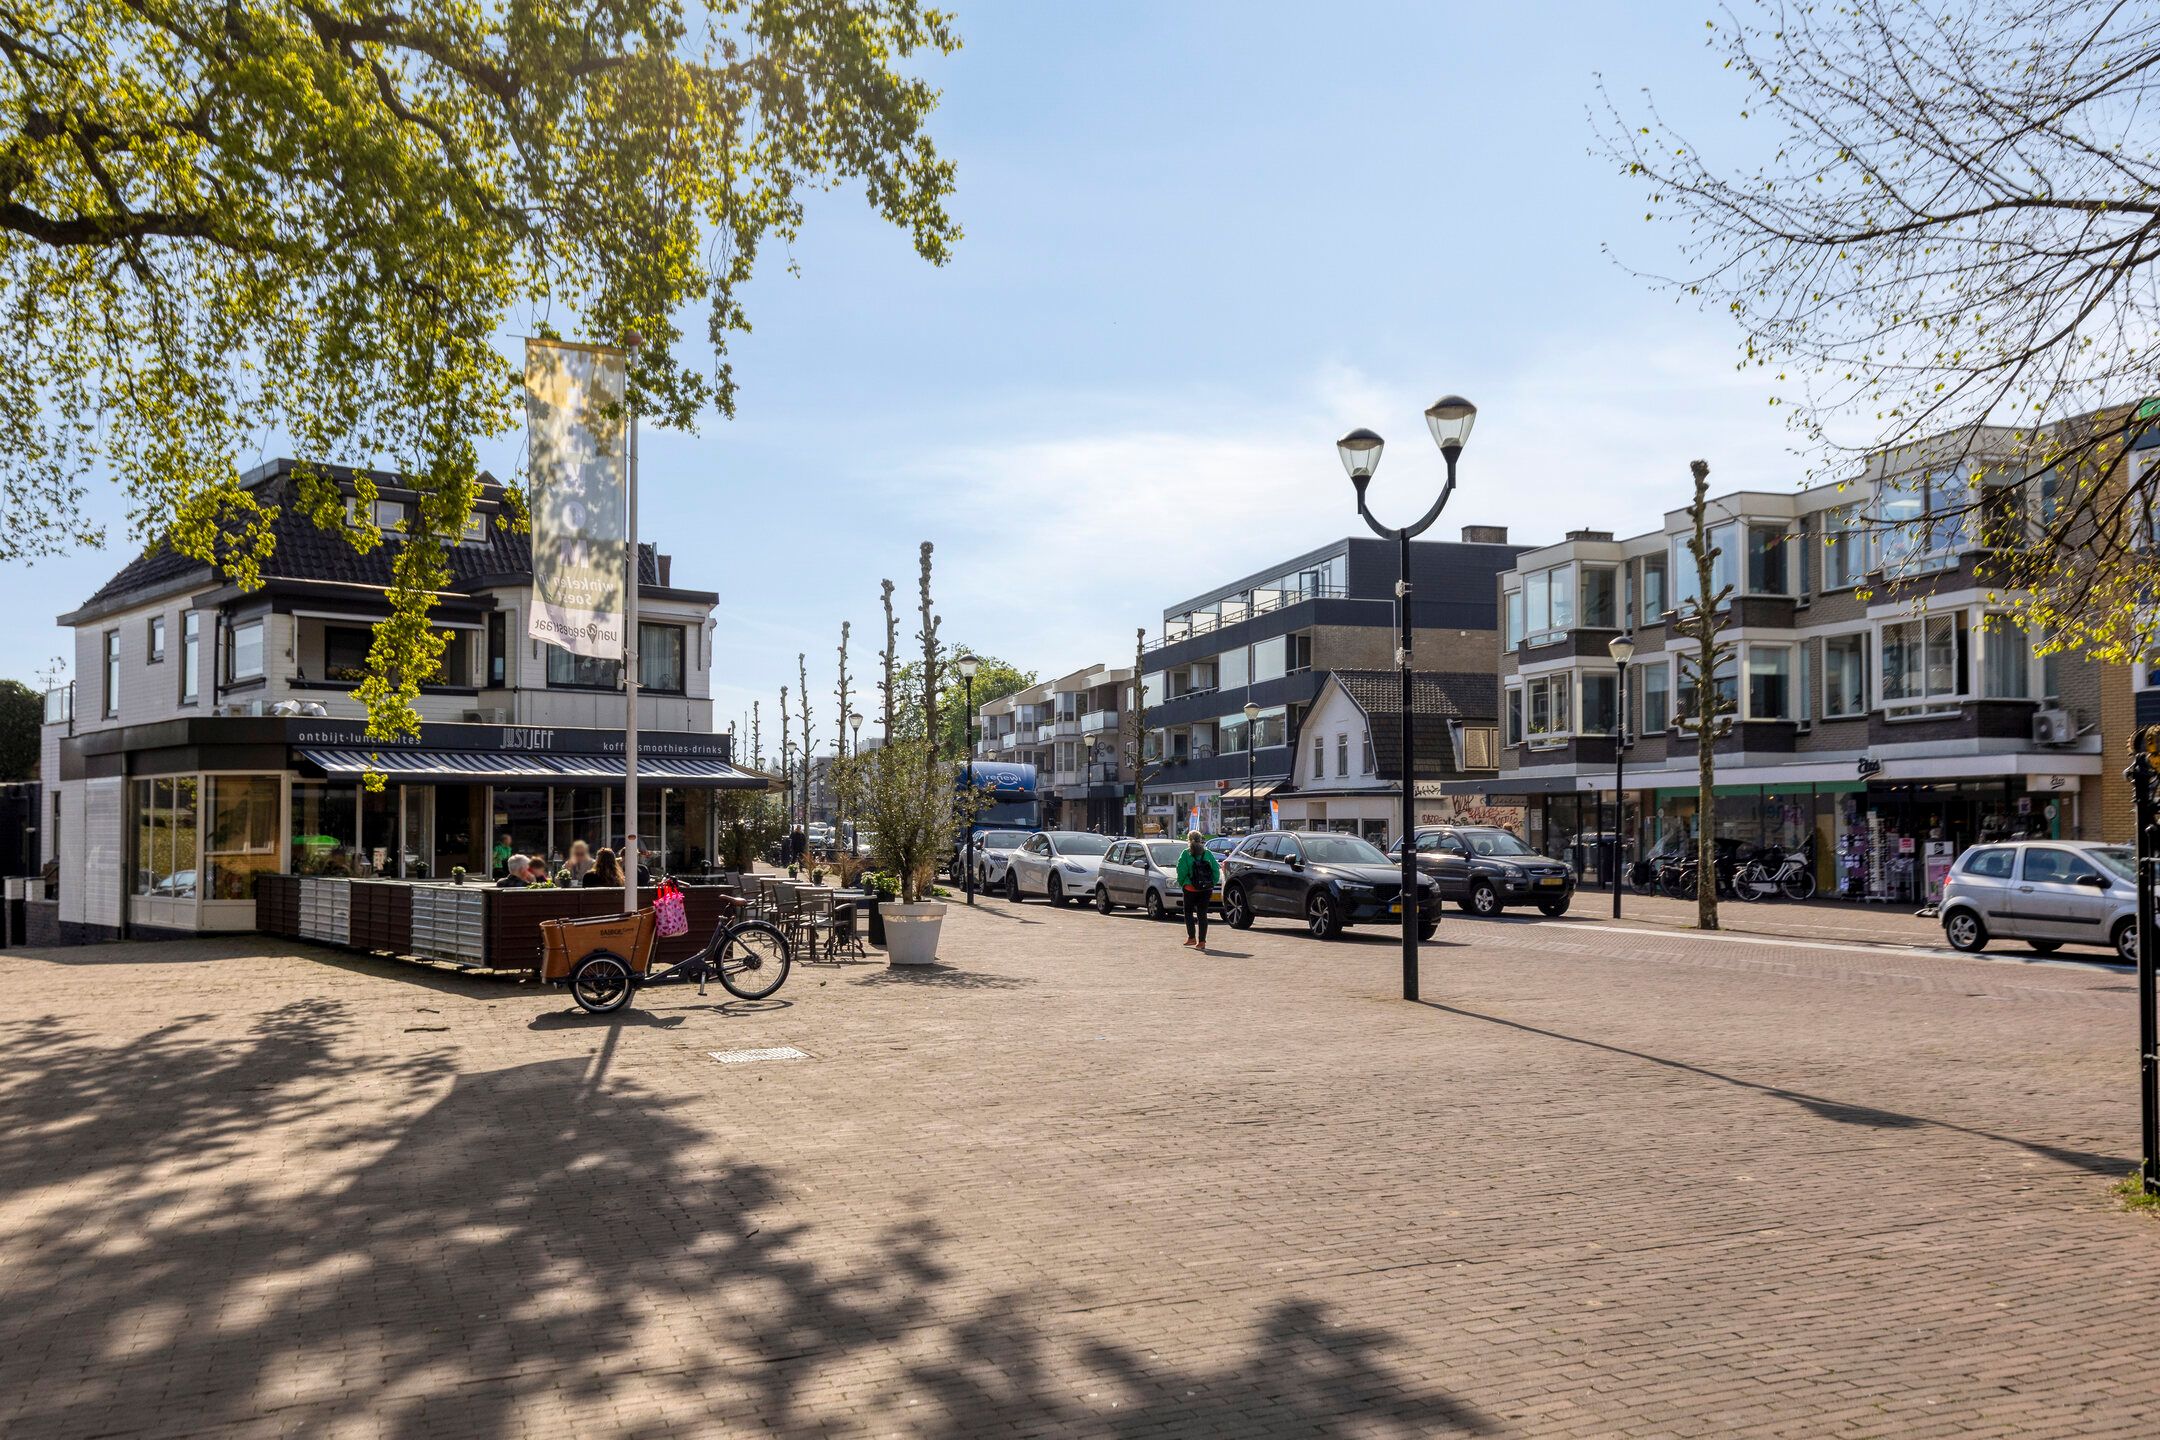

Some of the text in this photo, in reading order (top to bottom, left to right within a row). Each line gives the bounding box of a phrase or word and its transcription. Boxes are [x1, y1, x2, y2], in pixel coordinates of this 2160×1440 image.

[603, 742, 722, 754] koffi smoothies drinks
